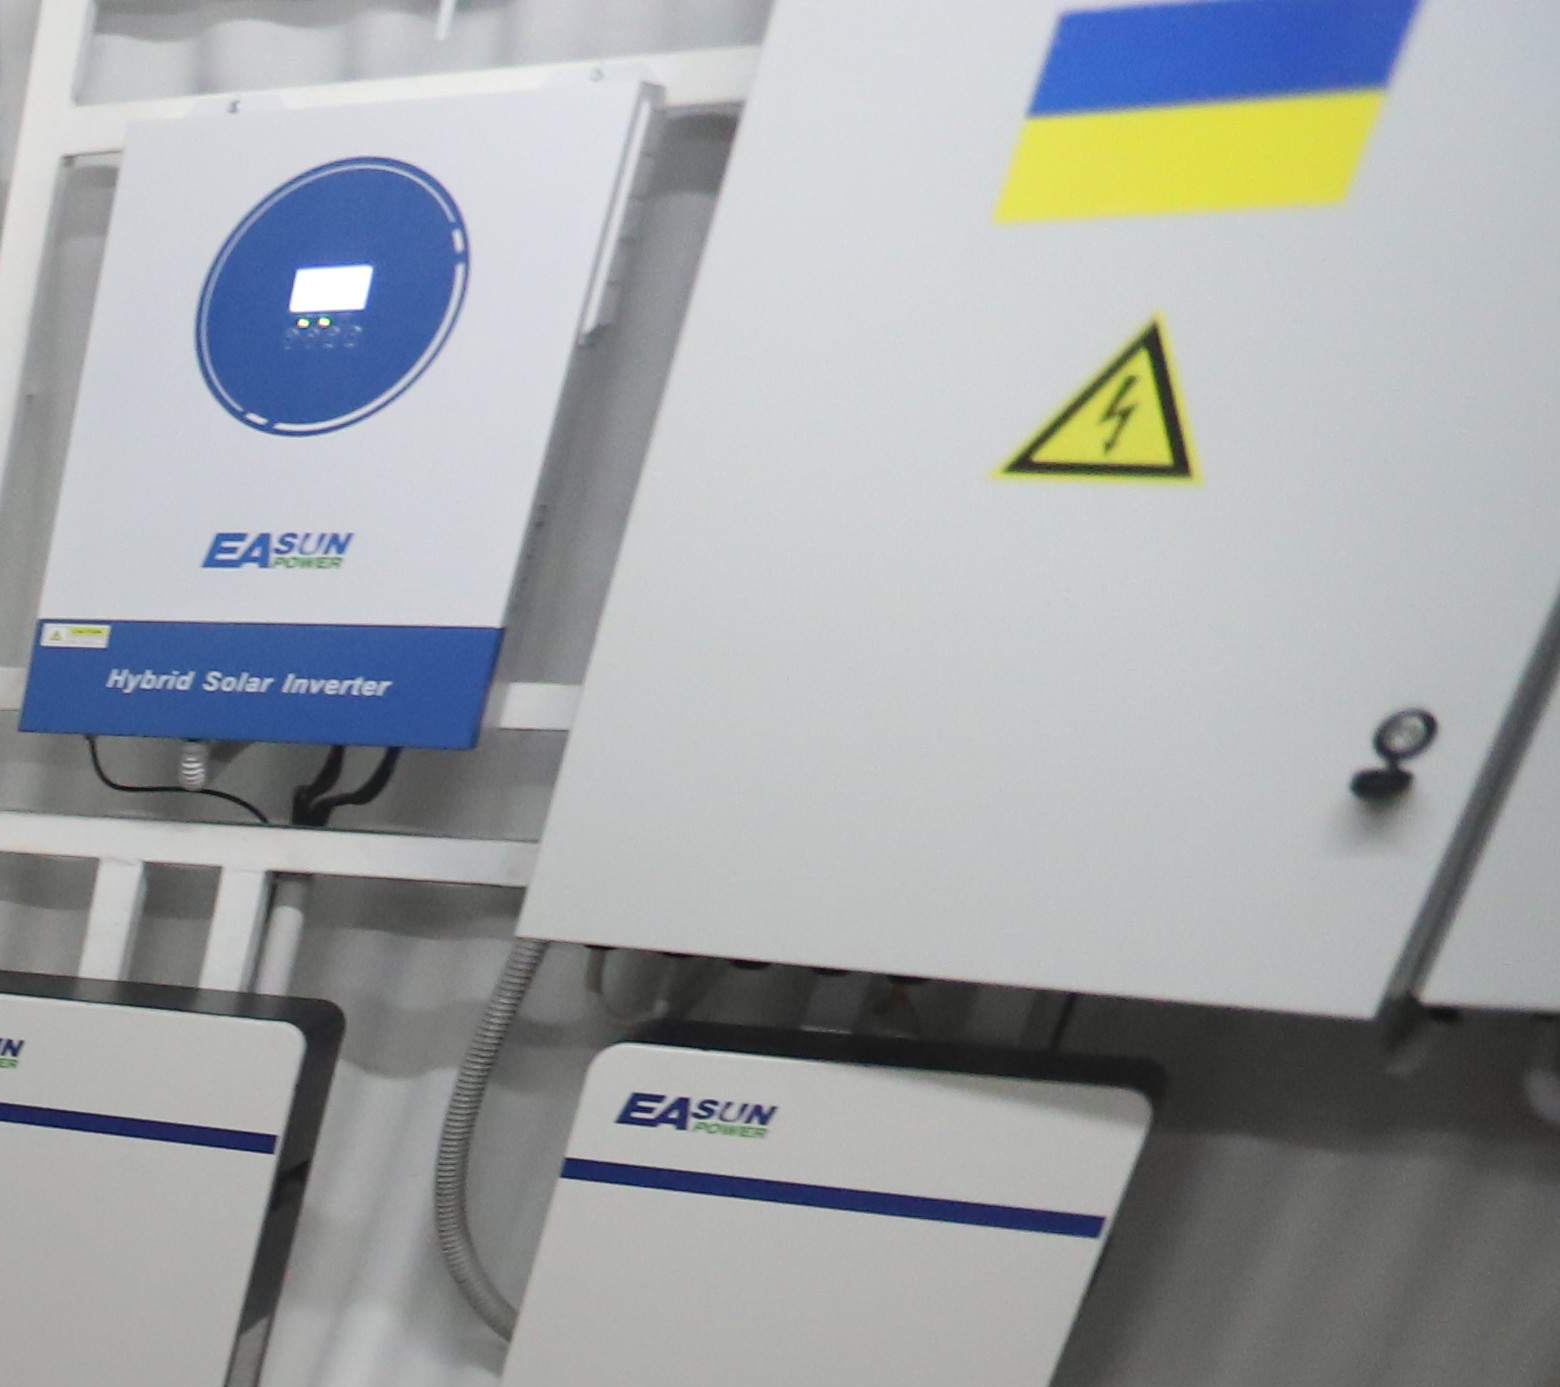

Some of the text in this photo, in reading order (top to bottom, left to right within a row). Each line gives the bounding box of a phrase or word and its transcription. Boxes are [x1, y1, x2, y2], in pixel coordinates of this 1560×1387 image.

[199, 532, 354, 568] EASUN
[273, 557, 343, 569] POWER
[106, 669, 393, 697] Hybrid Solar Inverter
[614, 1092, 778, 1131] EASUN
